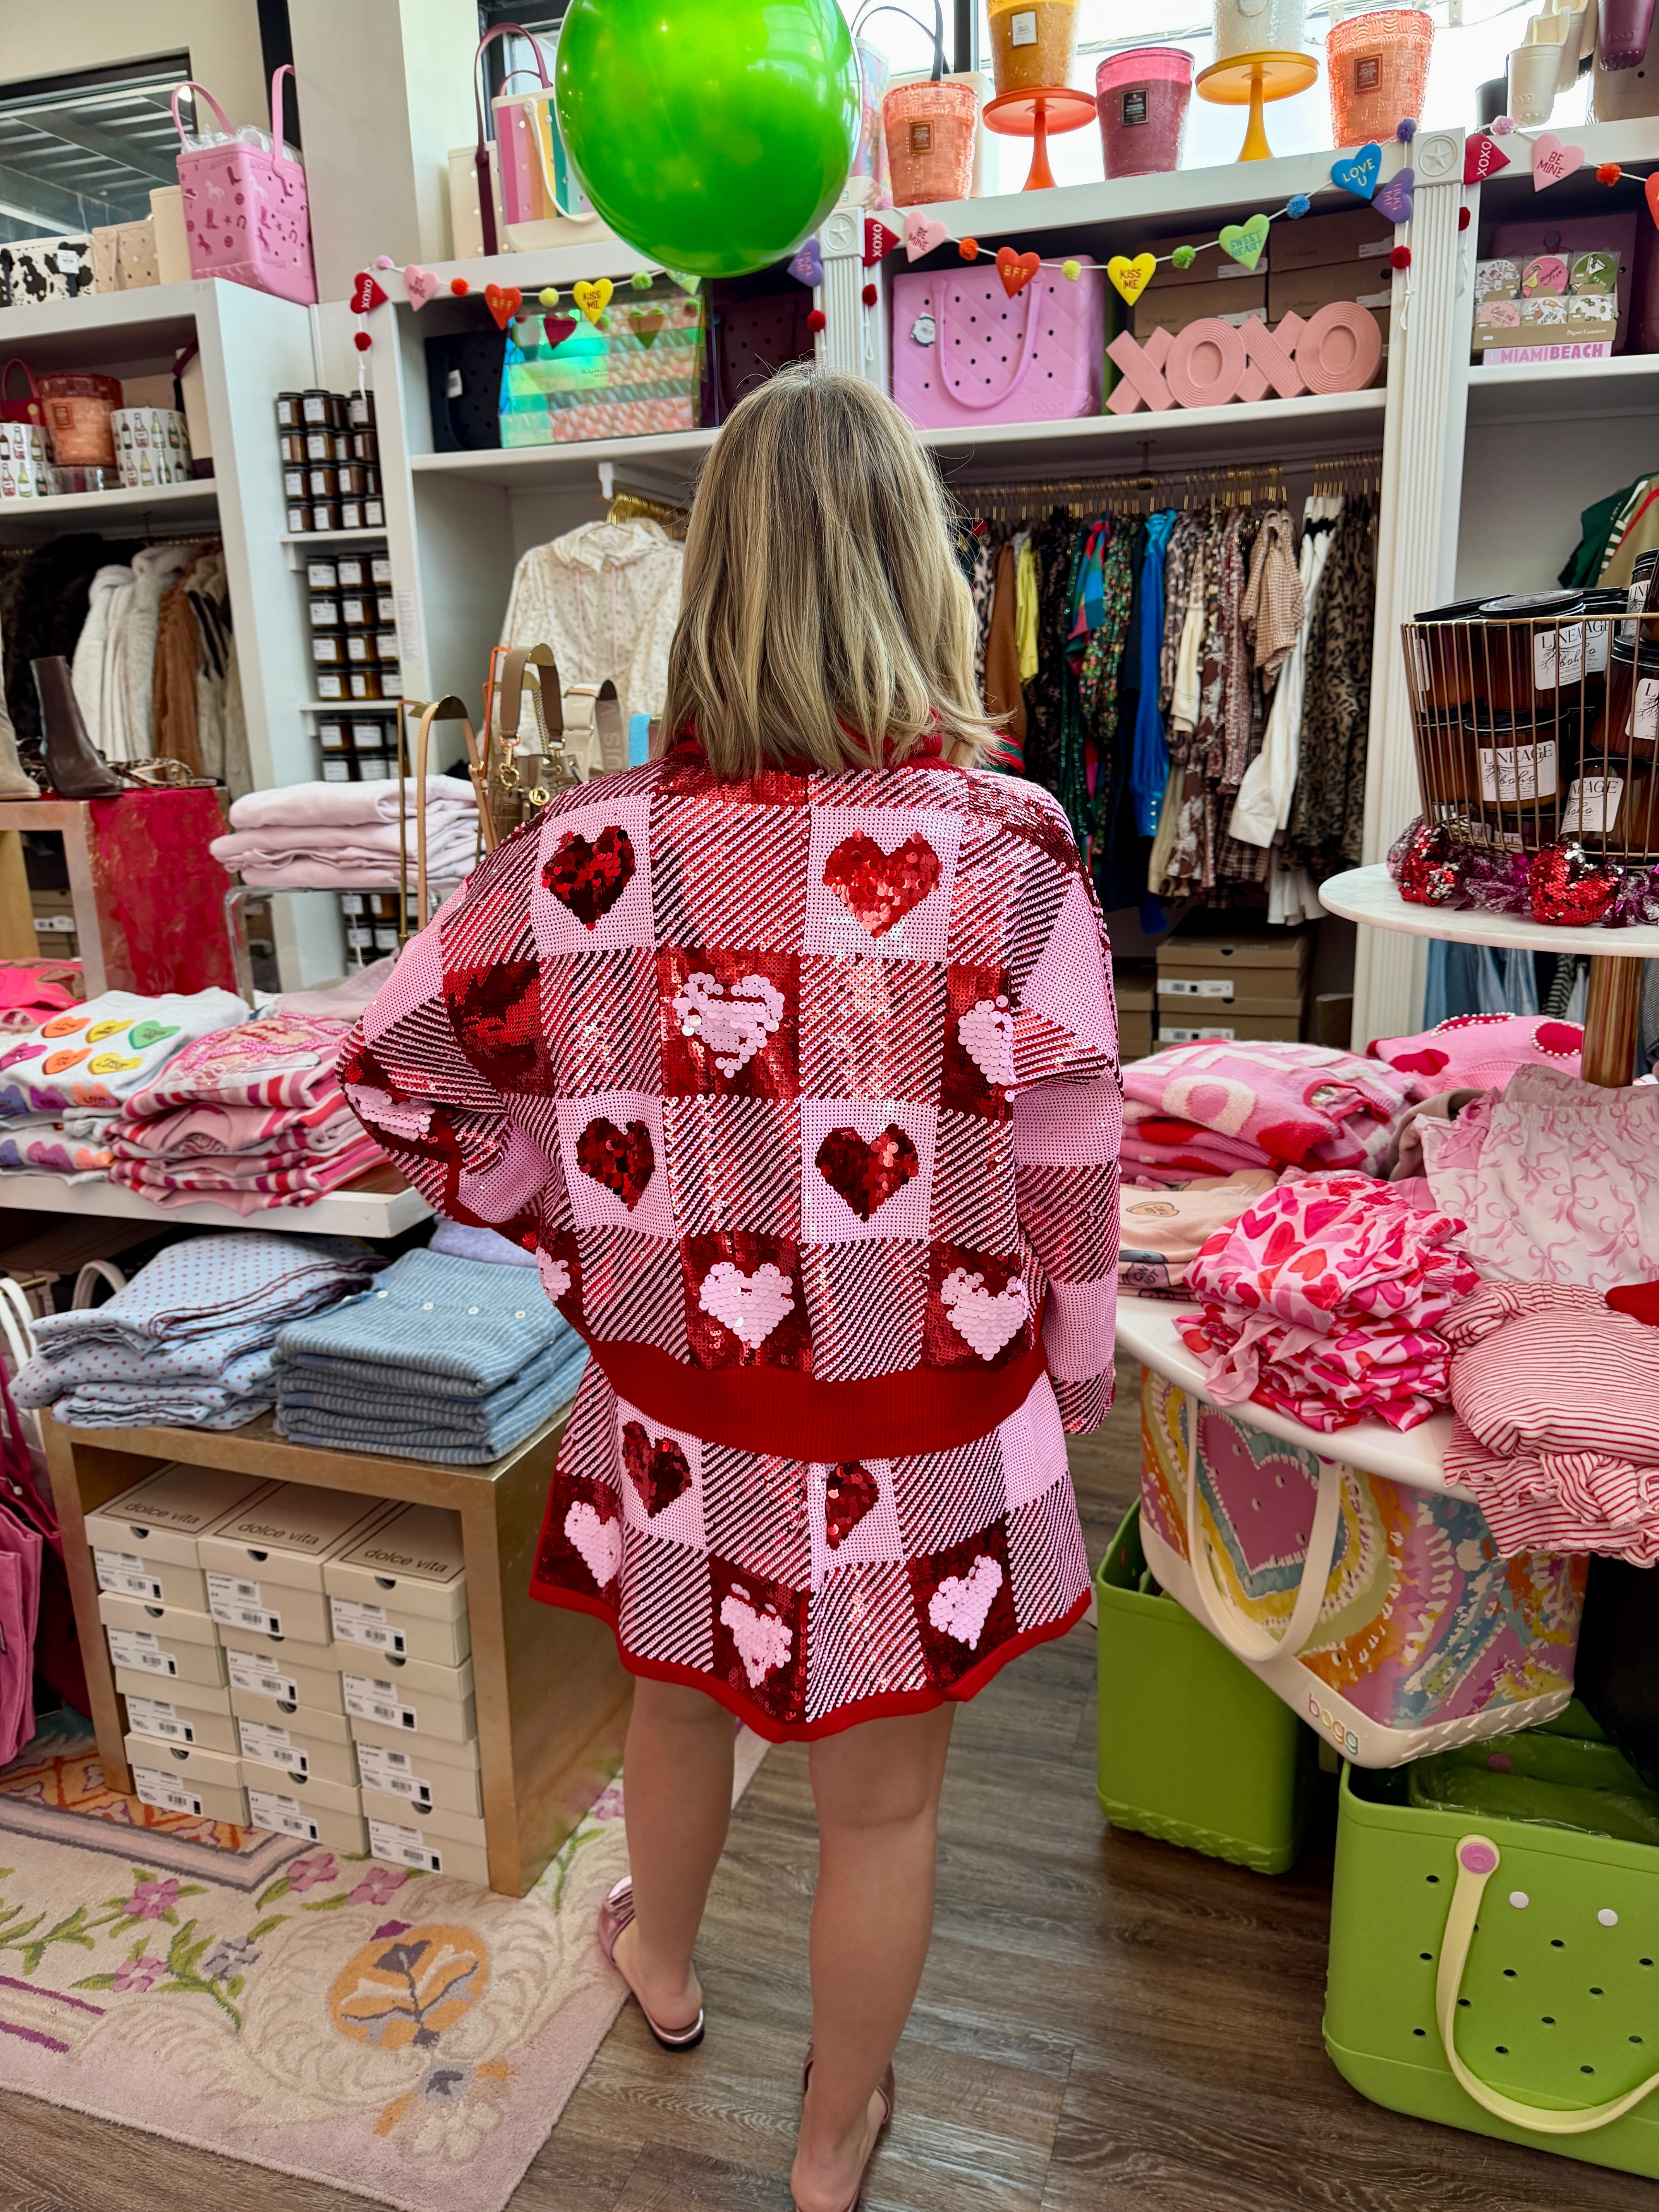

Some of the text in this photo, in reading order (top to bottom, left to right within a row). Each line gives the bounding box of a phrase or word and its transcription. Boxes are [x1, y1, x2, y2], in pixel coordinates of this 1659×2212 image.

[1476, 141, 1492, 177] XOXO
[1549, 151, 1564, 165] BE
[1342, 158, 1375, 183] LOVE
[1536, 159, 1565, 179] MINE
[1357, 175, 1367, 186] U
[1383, 190, 1393, 207] ME
[1392, 183, 1403, 211] HUG
[872, 223, 883, 258] XOXO
[908, 233, 929, 252] MINE
[916, 227, 928, 240] BE
[1229, 230, 1262, 249] SWEET
[1231, 239, 1262, 257] HEART
[1003, 264, 1029, 280] BFF
[1118, 268, 1142, 280] KISS
[361, 279, 374, 309] XOXO
[1123, 280, 1139, 290] ME
[1106, 301, 1382, 415] XOXO
[1484, 744, 1553, 764] LNEAGE
[125, 1502, 201, 1525] dolce vita
[237, 1522, 320, 1545] dolce vita
[364, 1548, 448, 1573] dolce vita
[1309, 1692, 1358, 1755] bogg
